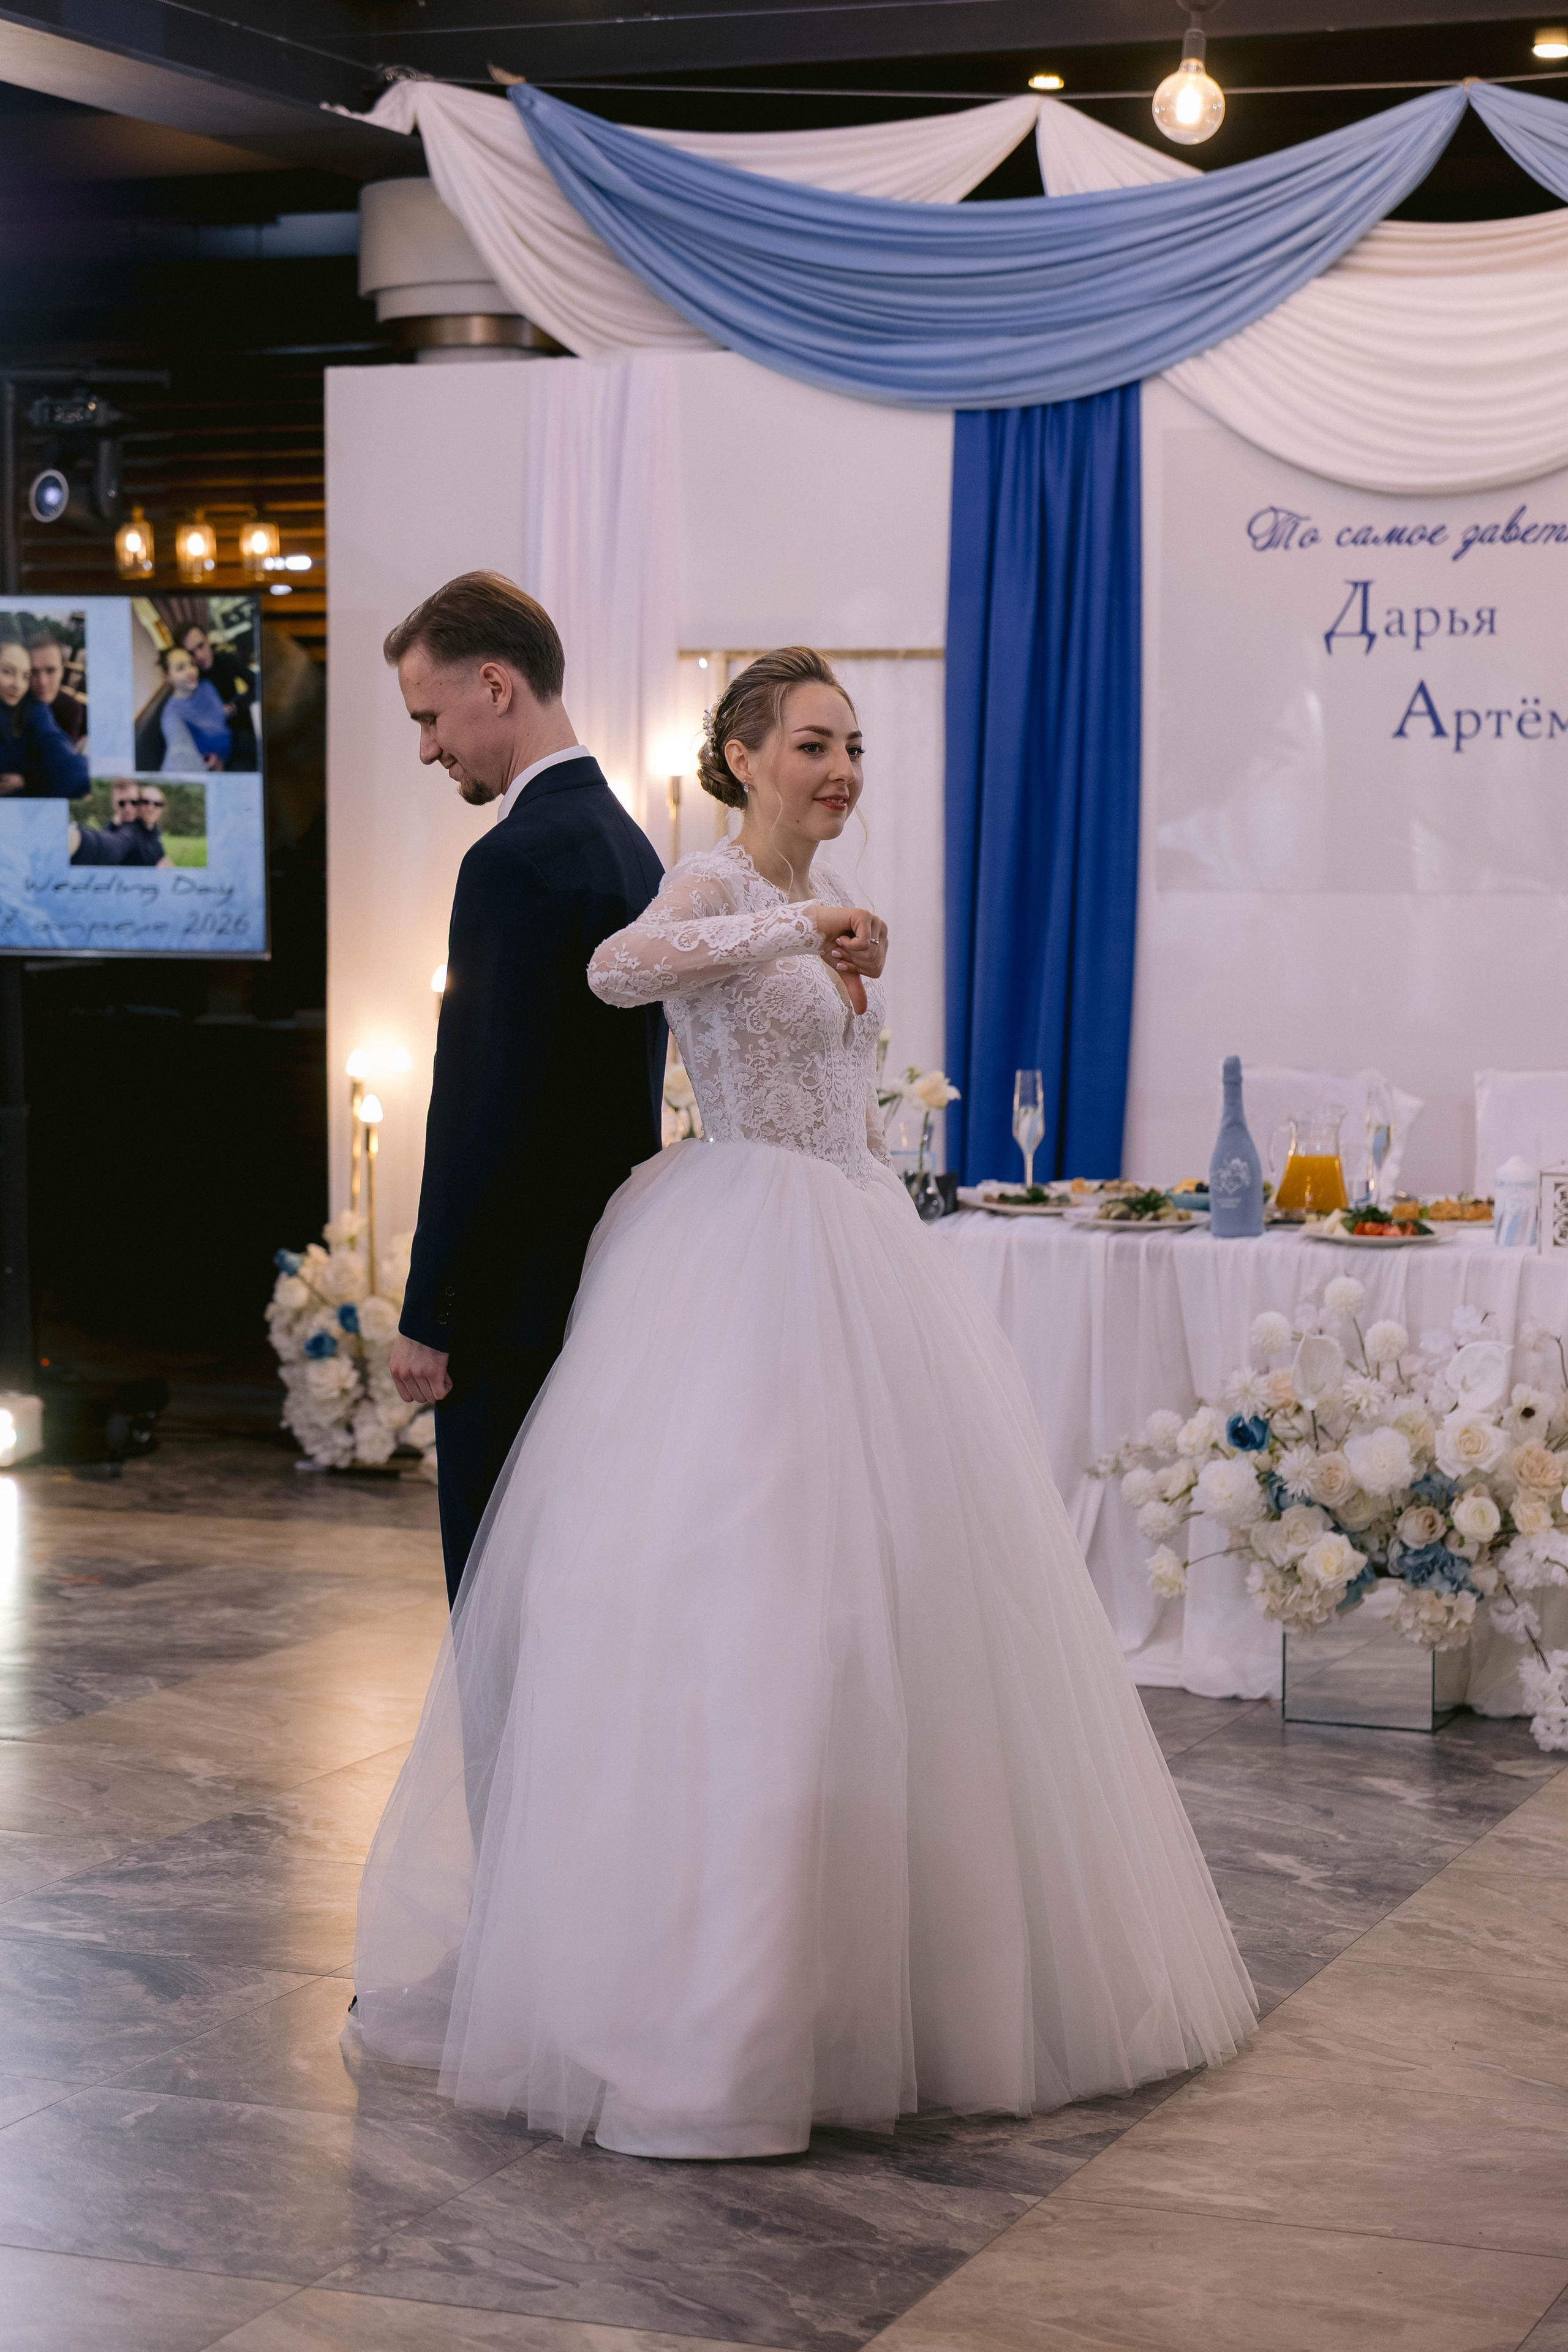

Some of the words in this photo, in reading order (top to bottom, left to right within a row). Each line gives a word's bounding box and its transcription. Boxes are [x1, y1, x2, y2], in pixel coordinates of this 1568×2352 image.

[1246, 505, 1321, 552] То
[1335, 524, 1448, 548] самое
[1451, 504, 1568, 562] завет
[1323, 579, 1497, 656] Дарья
[1391, 679, 1568, 754] Артём
[171, 875, 236, 907] Day
